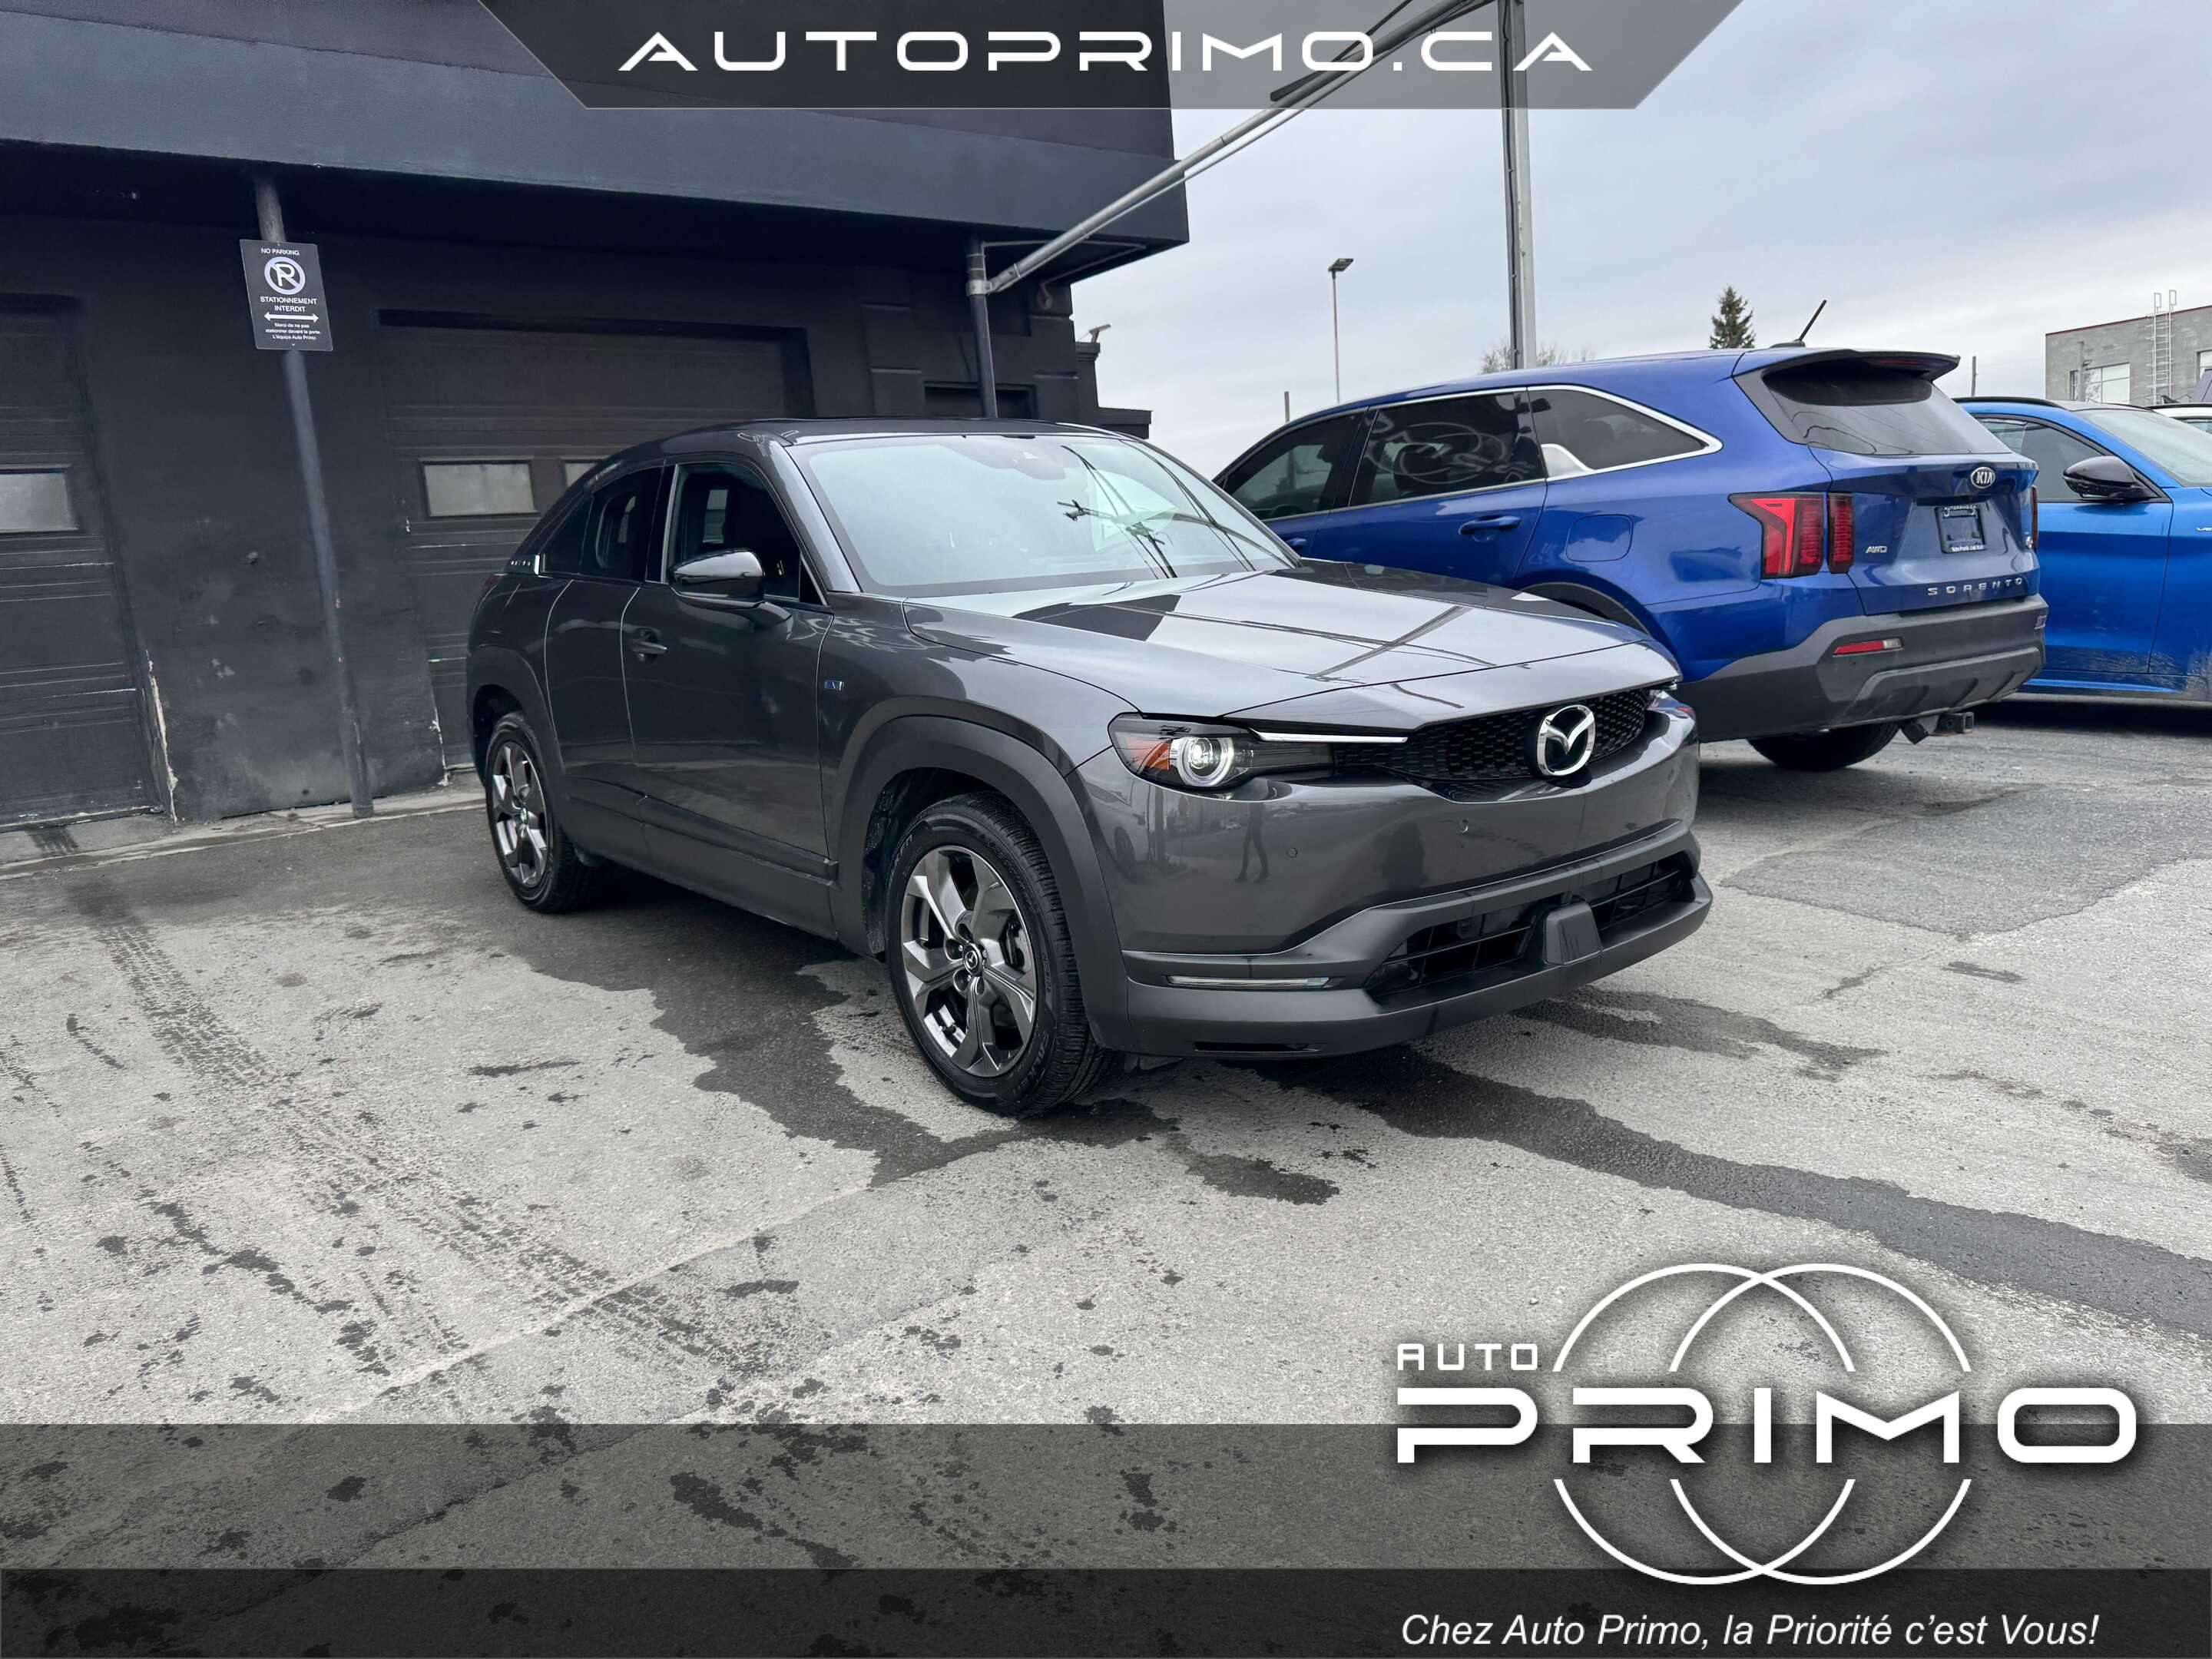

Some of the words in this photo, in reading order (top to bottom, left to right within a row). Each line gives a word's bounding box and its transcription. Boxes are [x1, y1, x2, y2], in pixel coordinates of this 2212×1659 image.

[260, 296, 318, 304] STATIONNEMENT
[1976, 472, 1993, 485] KIA
[1927, 578, 2022, 596] SORENTO
